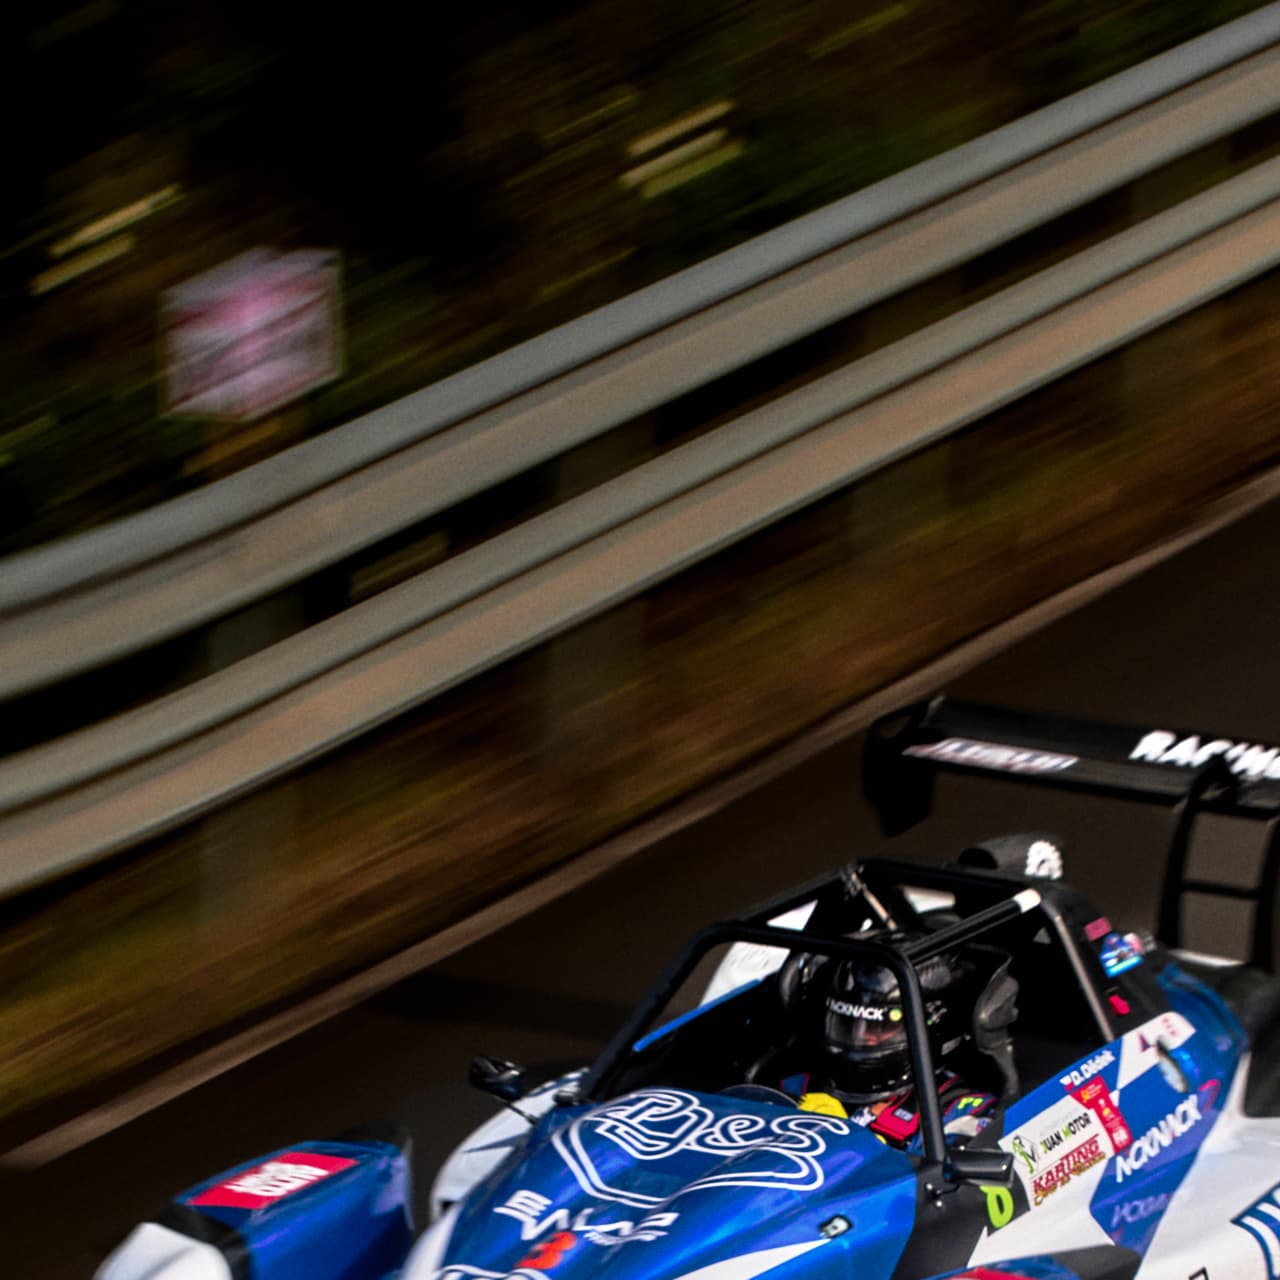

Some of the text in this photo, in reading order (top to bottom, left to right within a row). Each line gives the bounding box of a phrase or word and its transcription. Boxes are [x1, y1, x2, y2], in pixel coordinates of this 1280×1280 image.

[1040, 1130, 1064, 1154] JUAN
[1061, 1111, 1092, 1140] MOTOR
[1033, 1138, 1099, 1194] KARTING
